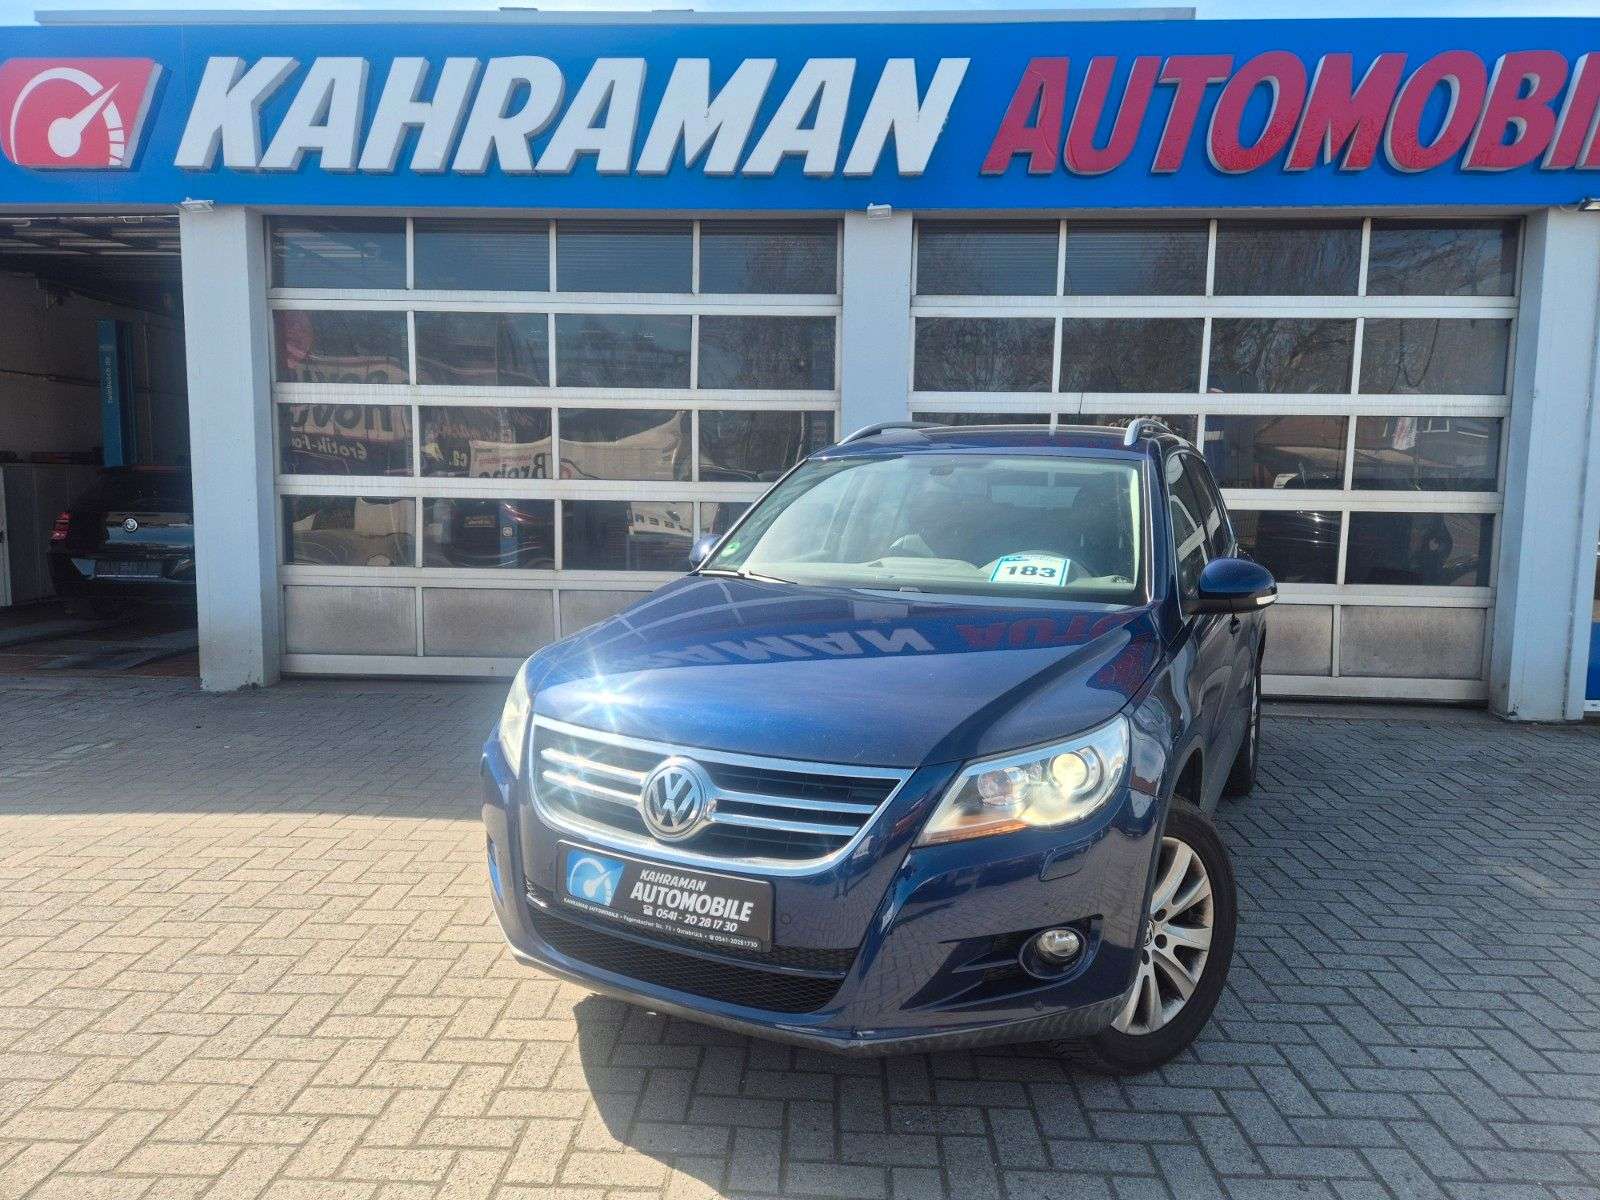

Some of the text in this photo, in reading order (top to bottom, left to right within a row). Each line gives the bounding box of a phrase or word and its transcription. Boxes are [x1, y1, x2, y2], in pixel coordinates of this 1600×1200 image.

[175, 55, 970, 176] KAHRAMAN
[1007, 566, 1057, 578] 183
[639, 868, 707, 892] KAHRAMAN
[630, 881, 755, 922] AUTOMOBILE
[655, 908, 678, 921] 0541
[684, 914, 698, 925] 20
[699, 917, 712, 928] 28
[712, 919, 723, 929] 17
[723, 921, 738, 933] 30
